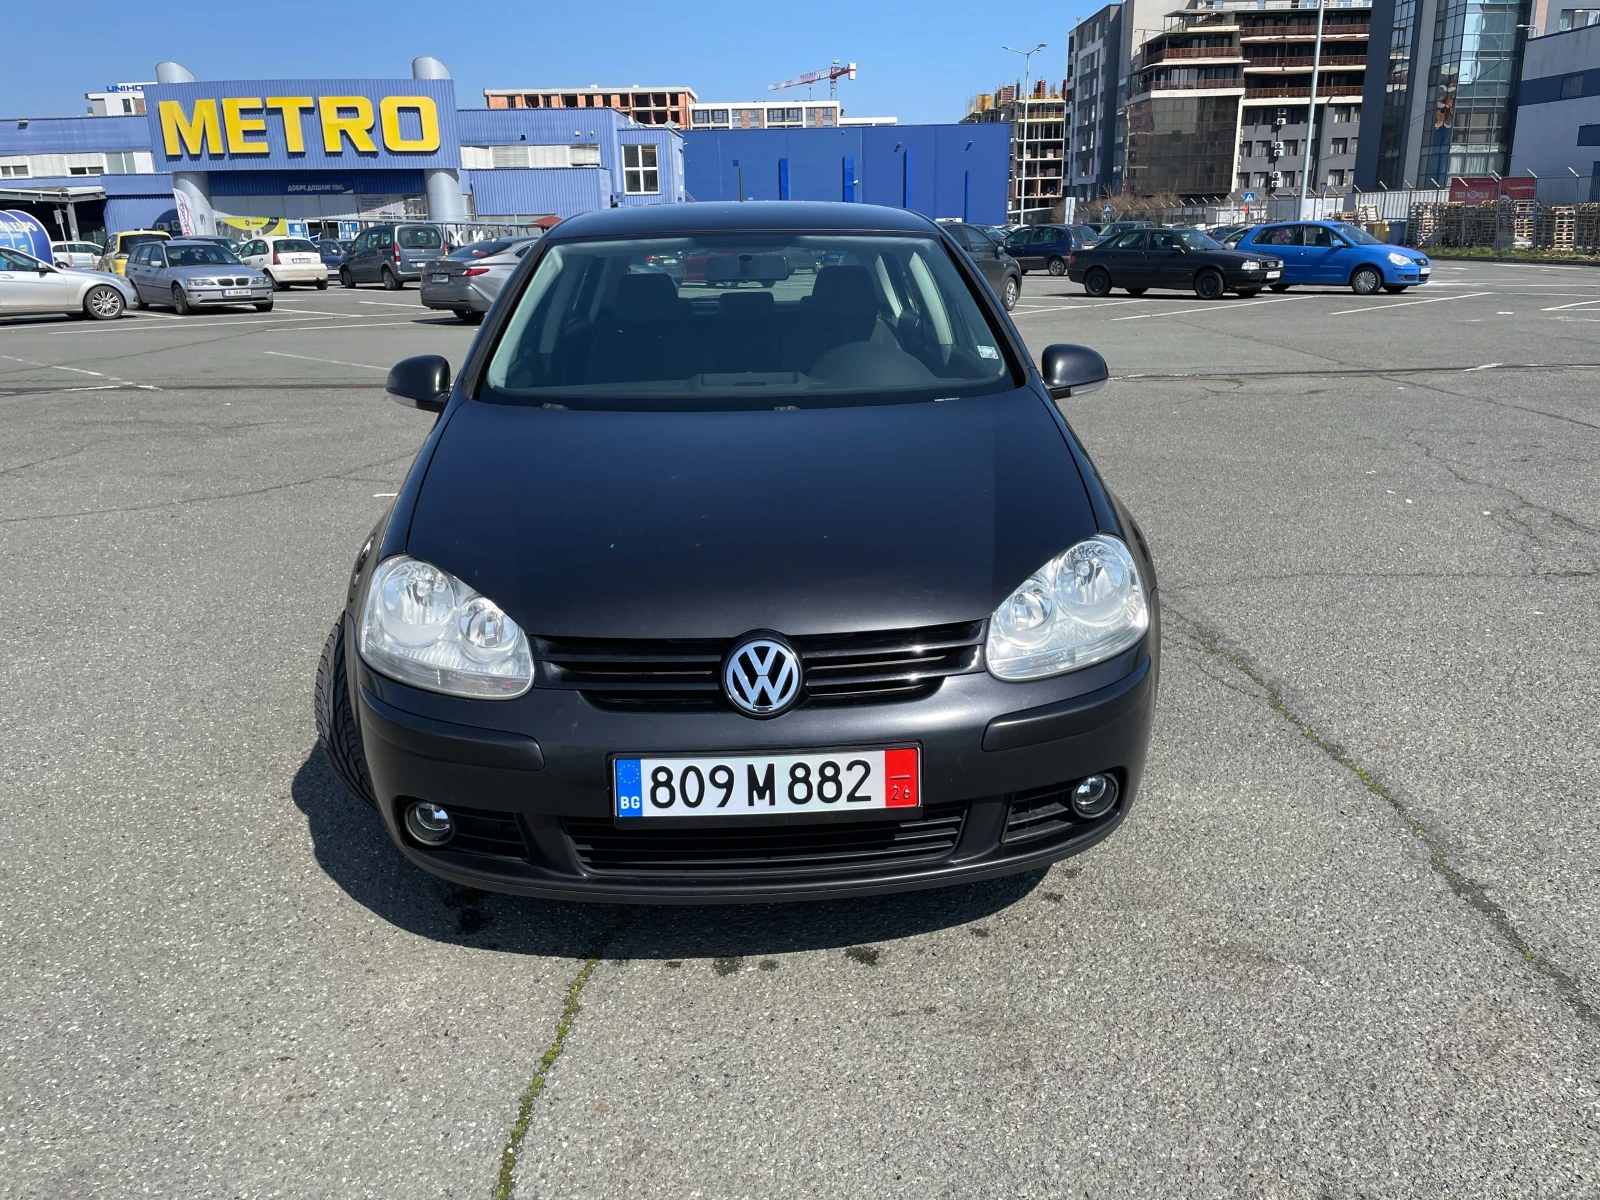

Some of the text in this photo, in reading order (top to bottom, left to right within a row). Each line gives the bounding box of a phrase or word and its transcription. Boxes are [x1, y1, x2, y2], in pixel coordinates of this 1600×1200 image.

[159, 96, 441, 155] METRO
[725, 639, 800, 713] VW
[620, 796, 640, 809] BG
[650, 759, 873, 809] 809 M 882
[891, 785, 911, 801] 26
